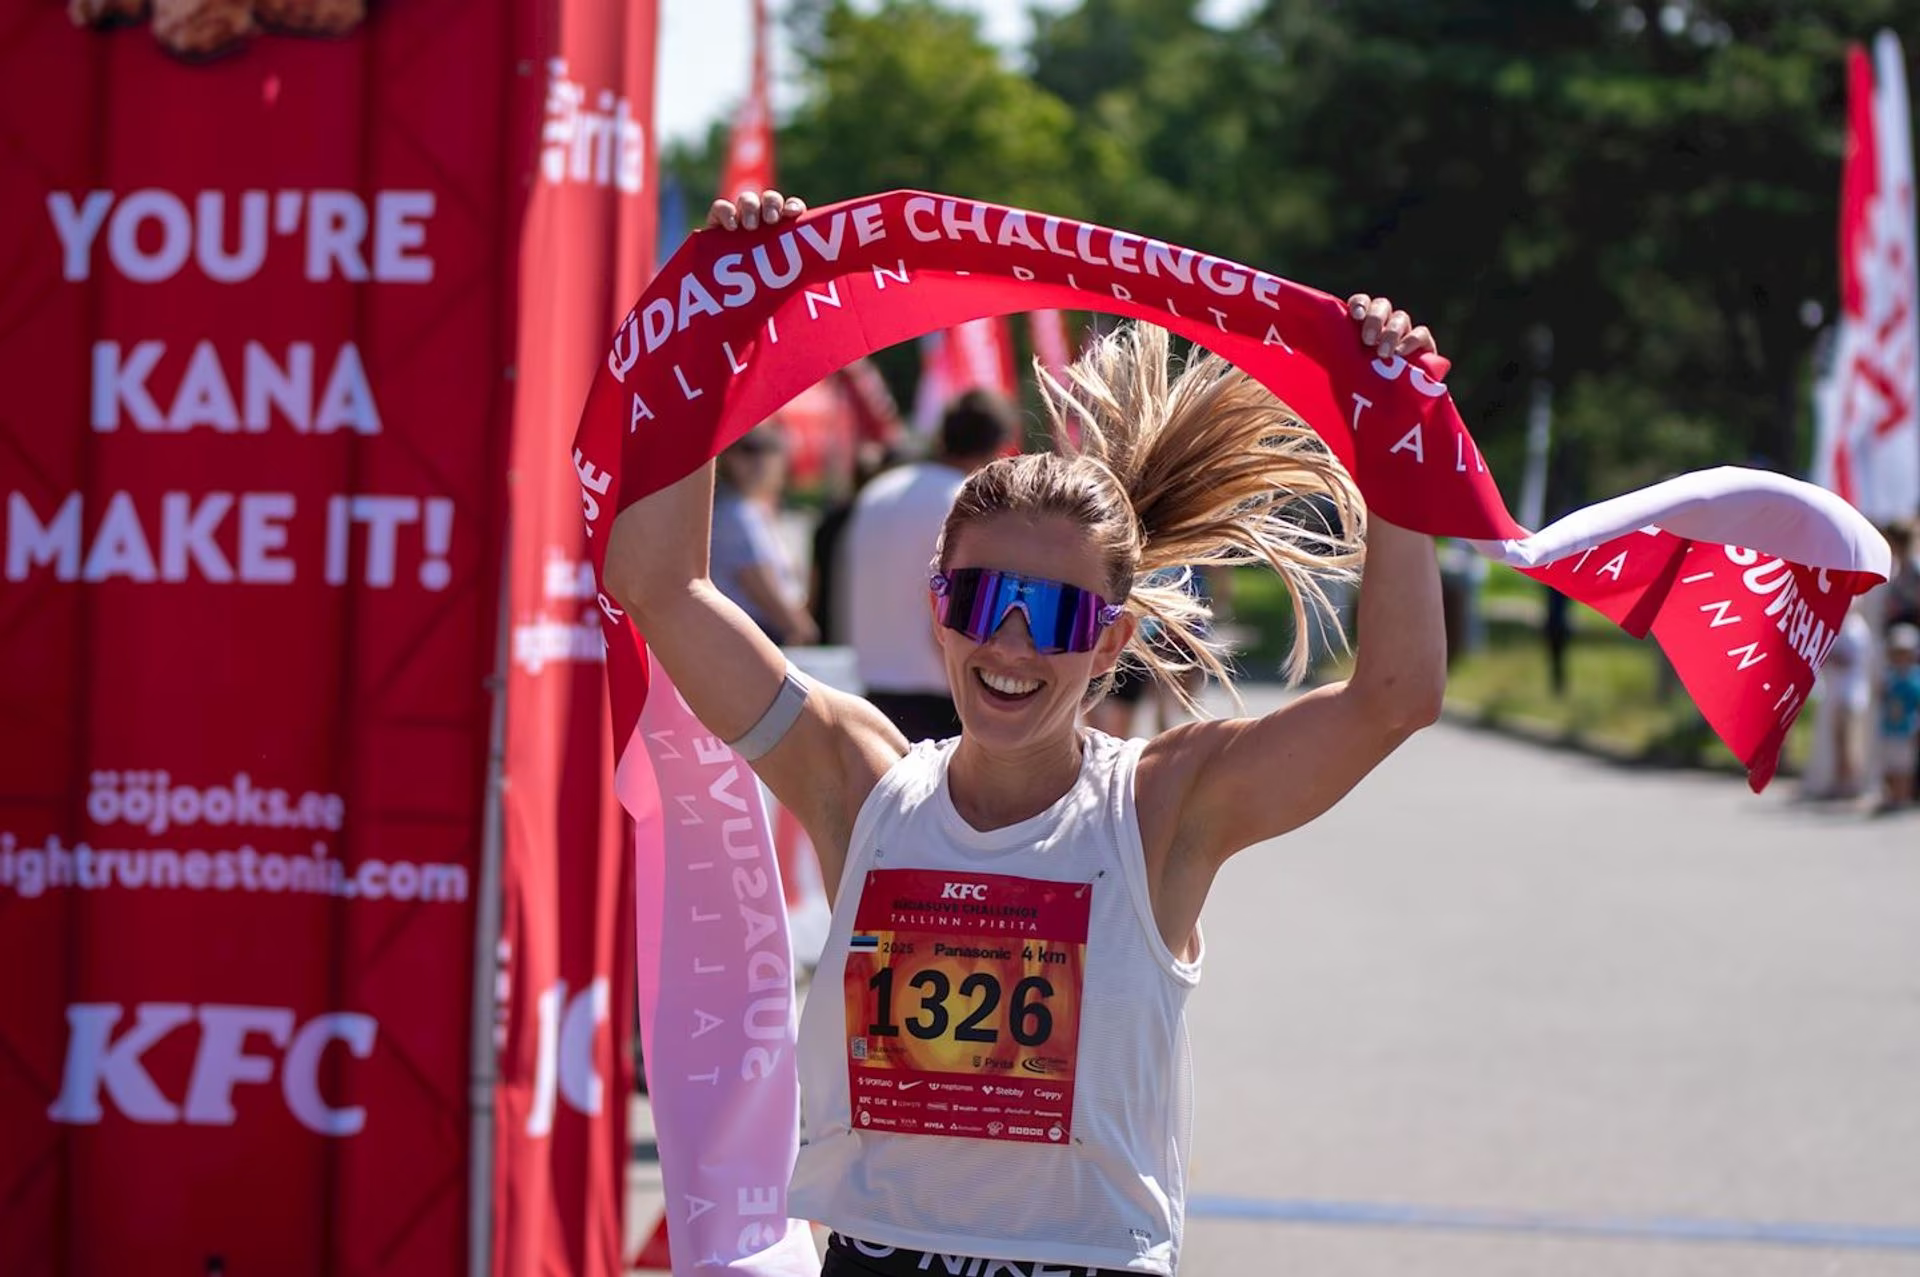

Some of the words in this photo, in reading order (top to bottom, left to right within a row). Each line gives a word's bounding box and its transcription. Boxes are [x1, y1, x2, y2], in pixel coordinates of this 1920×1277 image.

[47, 190, 435, 283] YOU'RE
[608, 203, 886, 383] SÜDASUVE
[904, 196, 1281, 310] CHALLENGE
[630, 259, 910, 433] ALLINN
[91, 340, 382, 434] KANA
[1352, 392, 1484, 473] TALL
[5, 490, 296, 583] MAKE
[325, 496, 454, 590] IT!
[87, 770, 344, 835] ööjooks.ee
[0, 832, 467, 903] ightrunestonia.com
[940, 882, 988, 900] KFC
[890, 913, 961, 927] TALLINN
[979, 919, 1038, 932] PIRITA
[934, 943, 1012, 961] Panasonic
[1021, 945, 1033, 962] 4
[1037, 947, 1067, 965] km
[868, 966, 1055, 1048] 1326
[48, 1003, 378, 1137] KFC
[995, 1085, 1025, 1098] Stebby
[1034, 1088, 1063, 1101] Cappy
